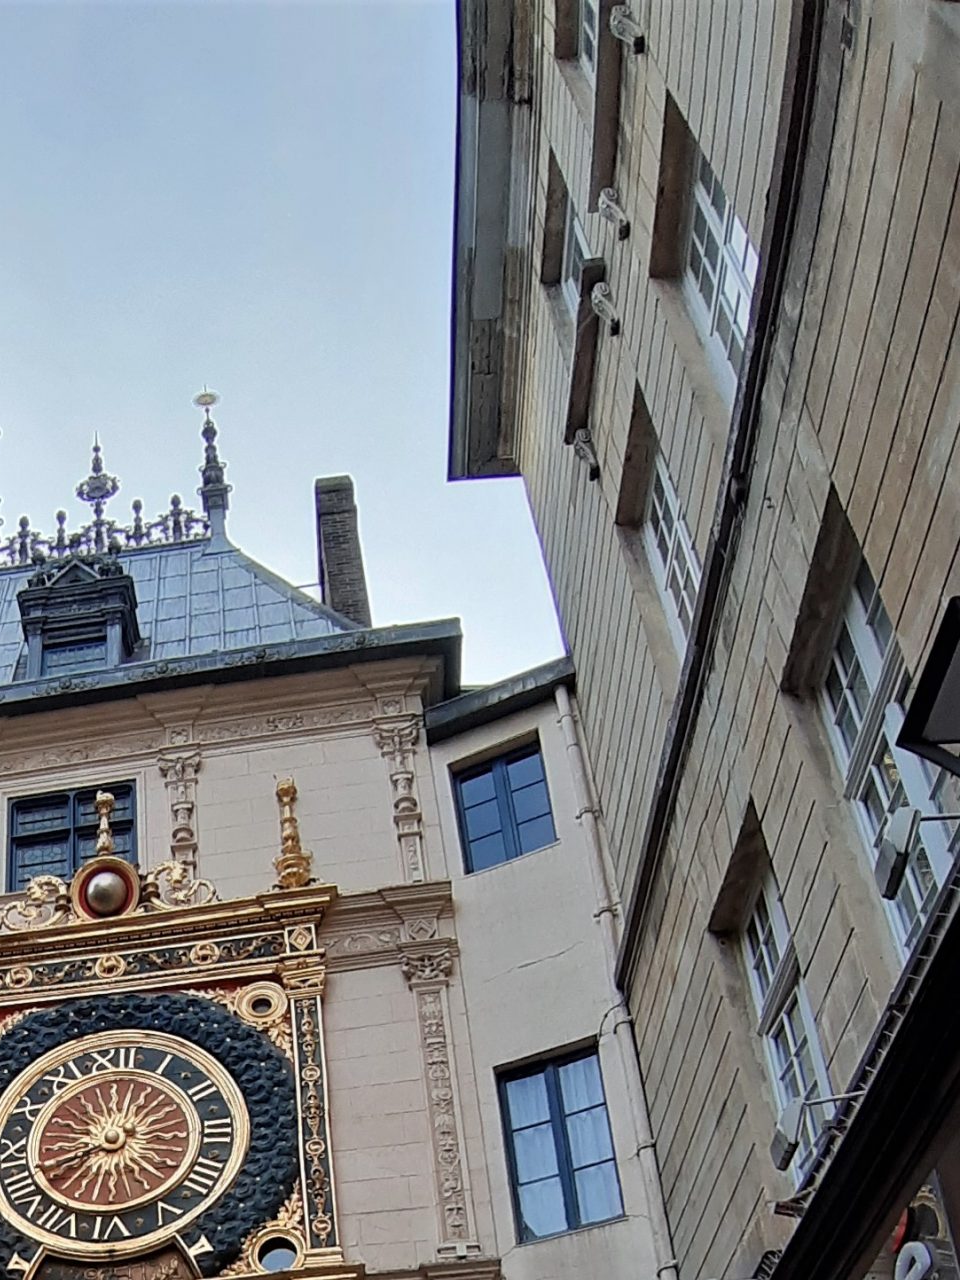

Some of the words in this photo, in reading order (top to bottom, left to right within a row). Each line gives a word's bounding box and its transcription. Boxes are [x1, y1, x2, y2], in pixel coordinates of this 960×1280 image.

[90, 1047, 136, 1073] XII
[156, 1053, 173, 1074] I
[43, 1060, 83, 1094] XI
[187, 1079, 217, 1101] II
[12, 1096, 46, 1121] X
[203, 1117, 231, 1143] III
[0, 1137, 27, 1169] IX
[182, 1156, 225, 1194] IIII
[4, 1170, 42, 1218] VIII
[36, 1204, 77, 1238] VII
[157, 1201, 184, 1226] V
[92, 1215, 131, 1240] VI
